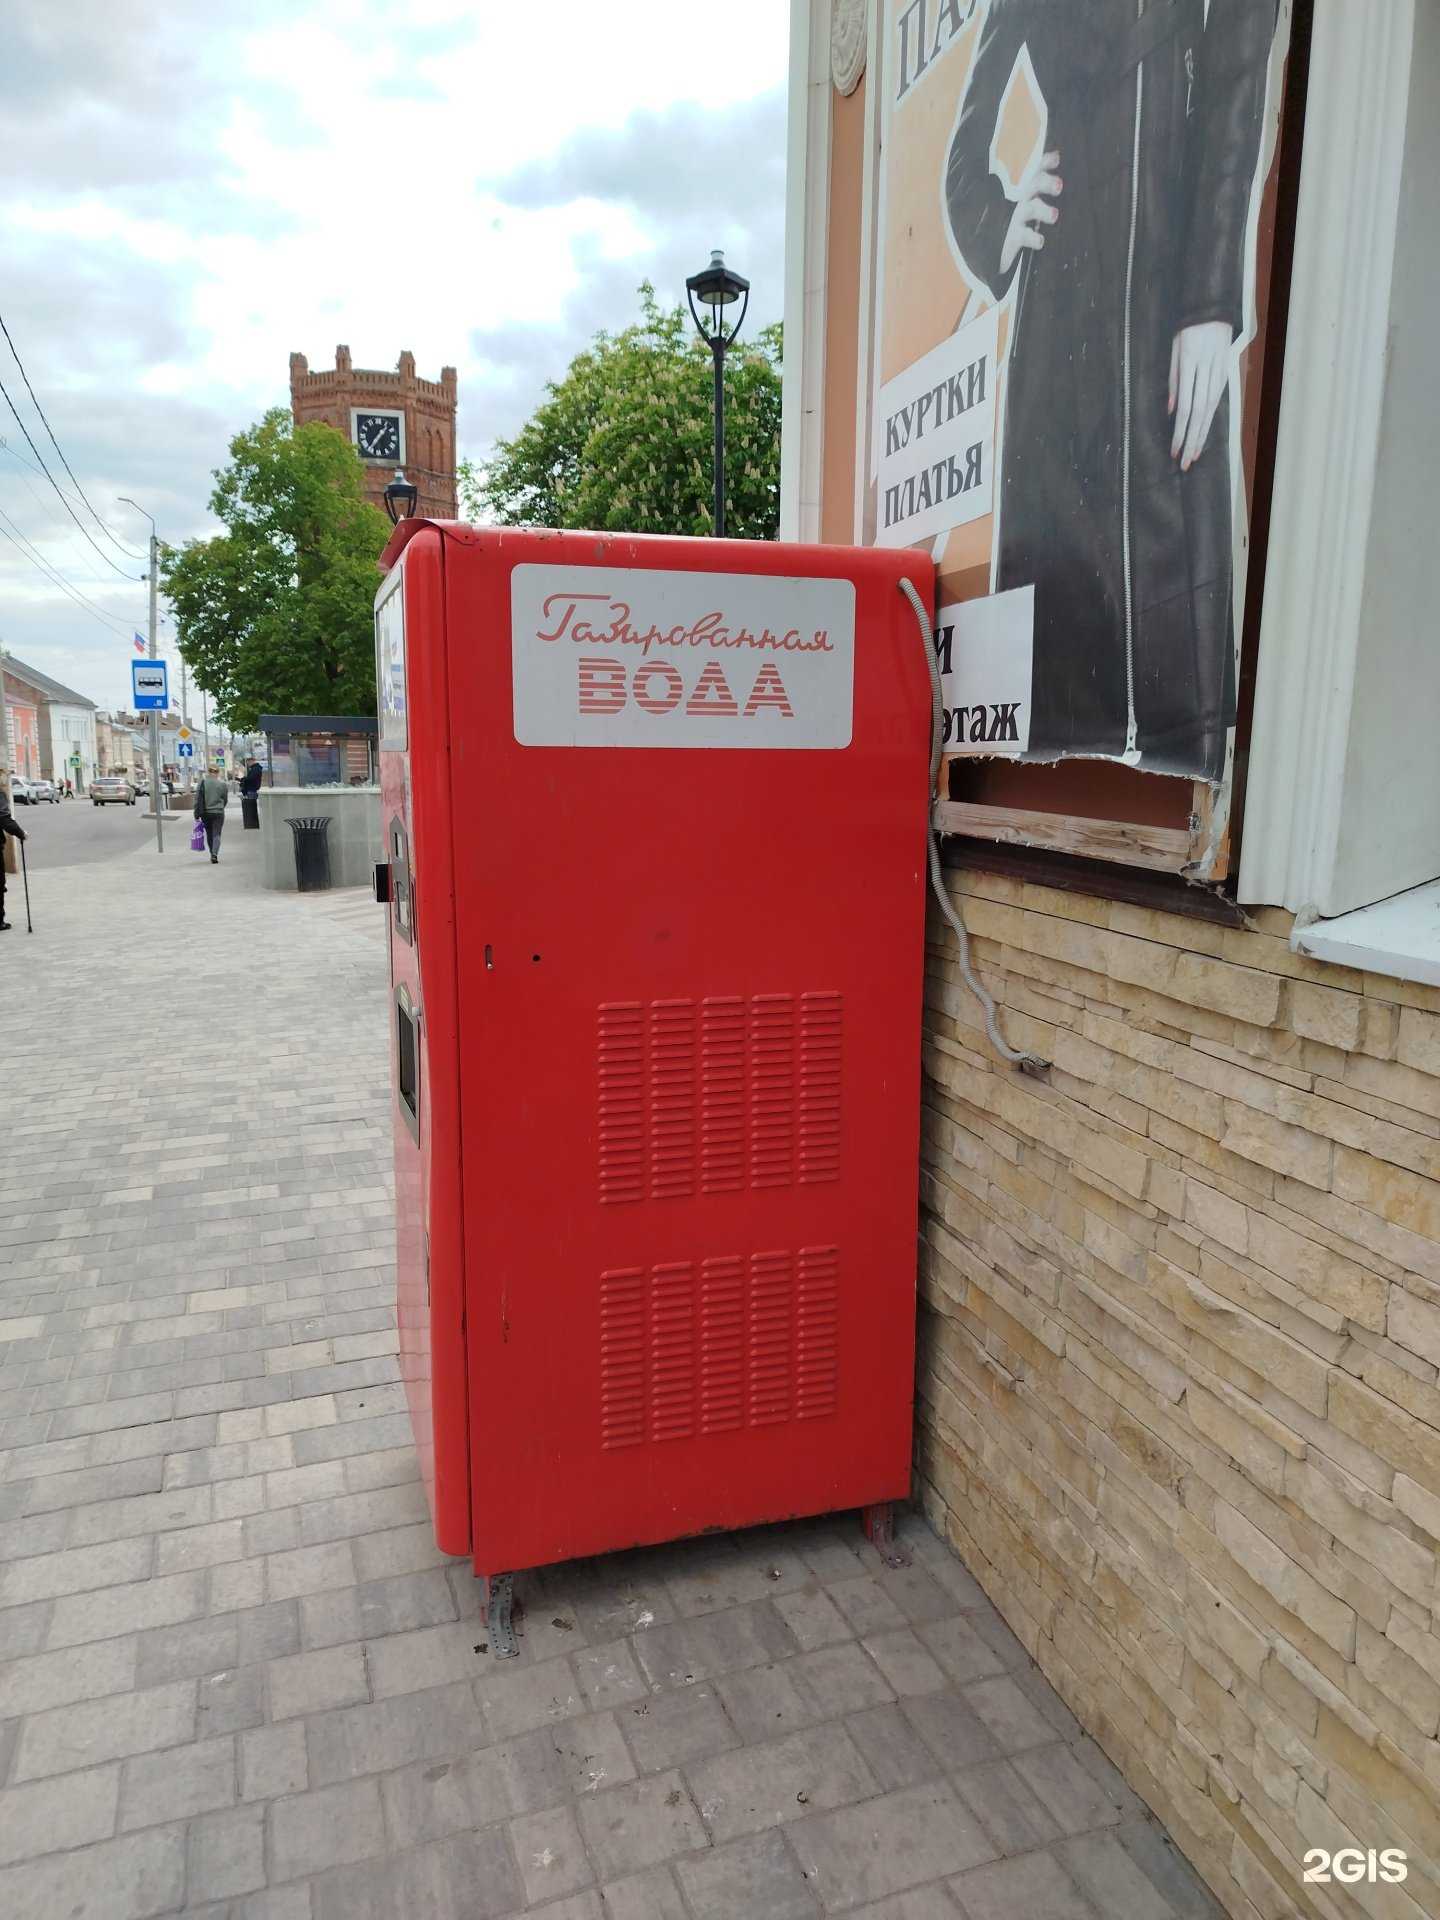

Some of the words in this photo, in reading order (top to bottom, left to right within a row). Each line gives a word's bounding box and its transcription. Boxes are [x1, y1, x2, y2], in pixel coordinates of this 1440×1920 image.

[897, 0, 977, 101] ПА
[885, 354, 988, 458] КУРТКИ
[884, 440, 984, 528] ПЛАТЬЯ
[535, 593, 835, 657] Газированная
[578, 657, 795, 718] ВОДА
